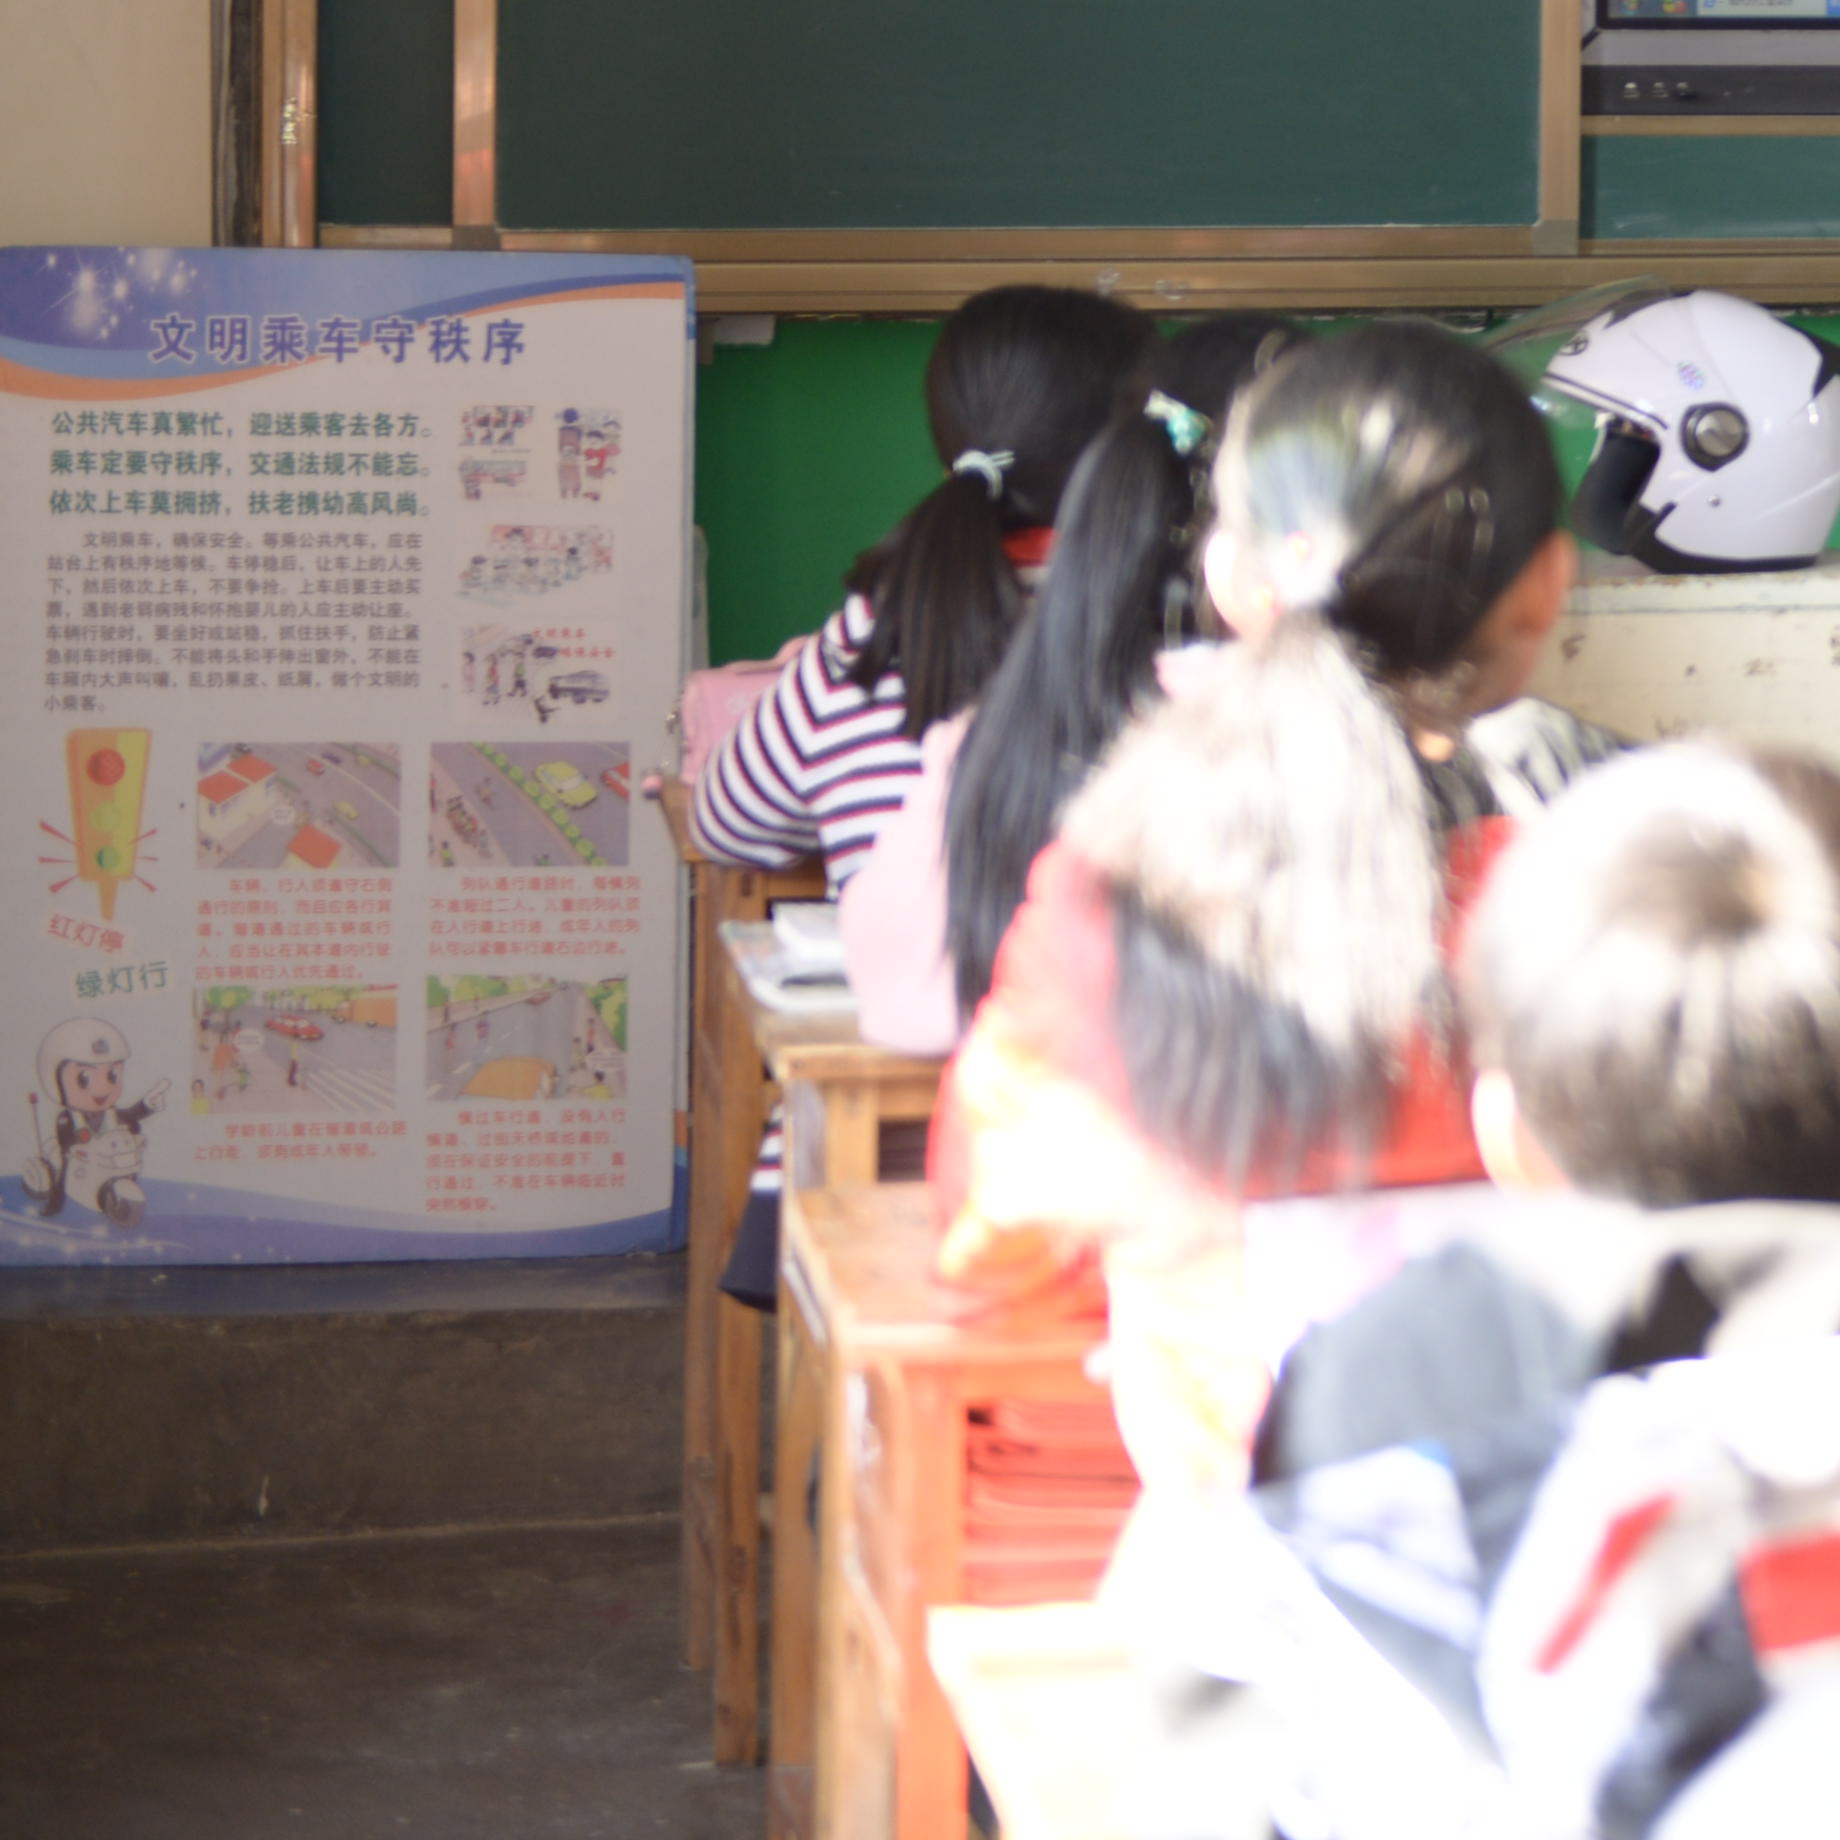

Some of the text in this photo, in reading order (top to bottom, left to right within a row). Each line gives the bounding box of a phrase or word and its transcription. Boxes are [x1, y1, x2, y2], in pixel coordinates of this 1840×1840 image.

[151, 314, 526, 365] 文明乘车守秩序
[47, 914, 125, 953] 红灯停
[76, 961, 168, 998] 绿灯行
